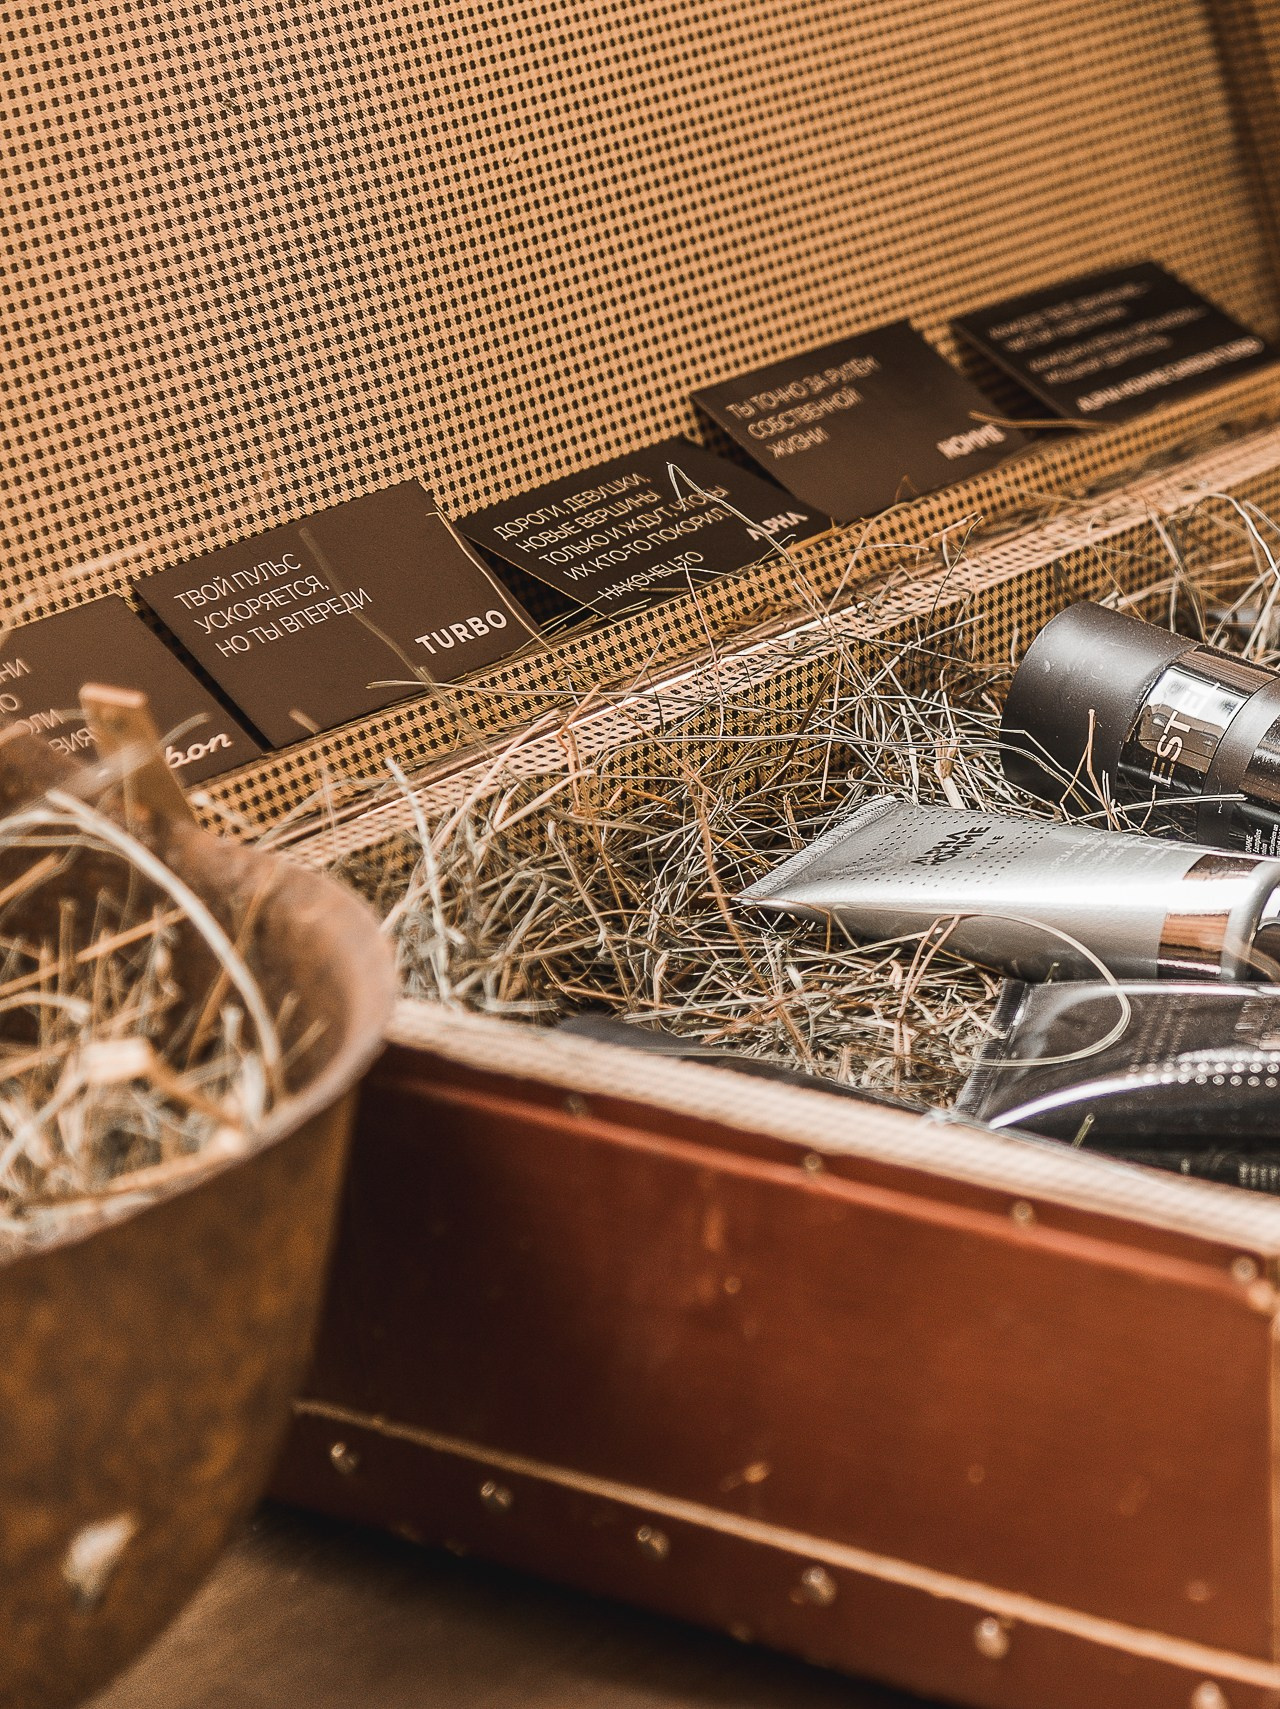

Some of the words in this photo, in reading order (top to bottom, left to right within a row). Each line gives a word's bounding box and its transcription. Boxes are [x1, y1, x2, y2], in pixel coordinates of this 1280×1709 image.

[493, 504, 570, 541] ДОРОГИ,
[515, 521, 582, 553] НОВЫЕ
[575, 489, 661, 529] ВЕРШИНЫ
[538, 534, 610, 566] ТОЛЬКО
[604, 527, 627, 540] И
[173, 575, 236, 610] ТВОЙ
[231, 553, 302, 586] ПУЛЬС
[563, 563, 596, 581] ИХ
[588, 539, 652, 570] КТО-ТО
[193, 574, 330, 635] УСКОРЯЕТСЯ,
[214, 634, 250, 658] НО
[247, 621, 284, 644] ТЫ
[279, 587, 373, 633] ВПЕРЕДИ
[414, 608, 508, 655] TURBO
